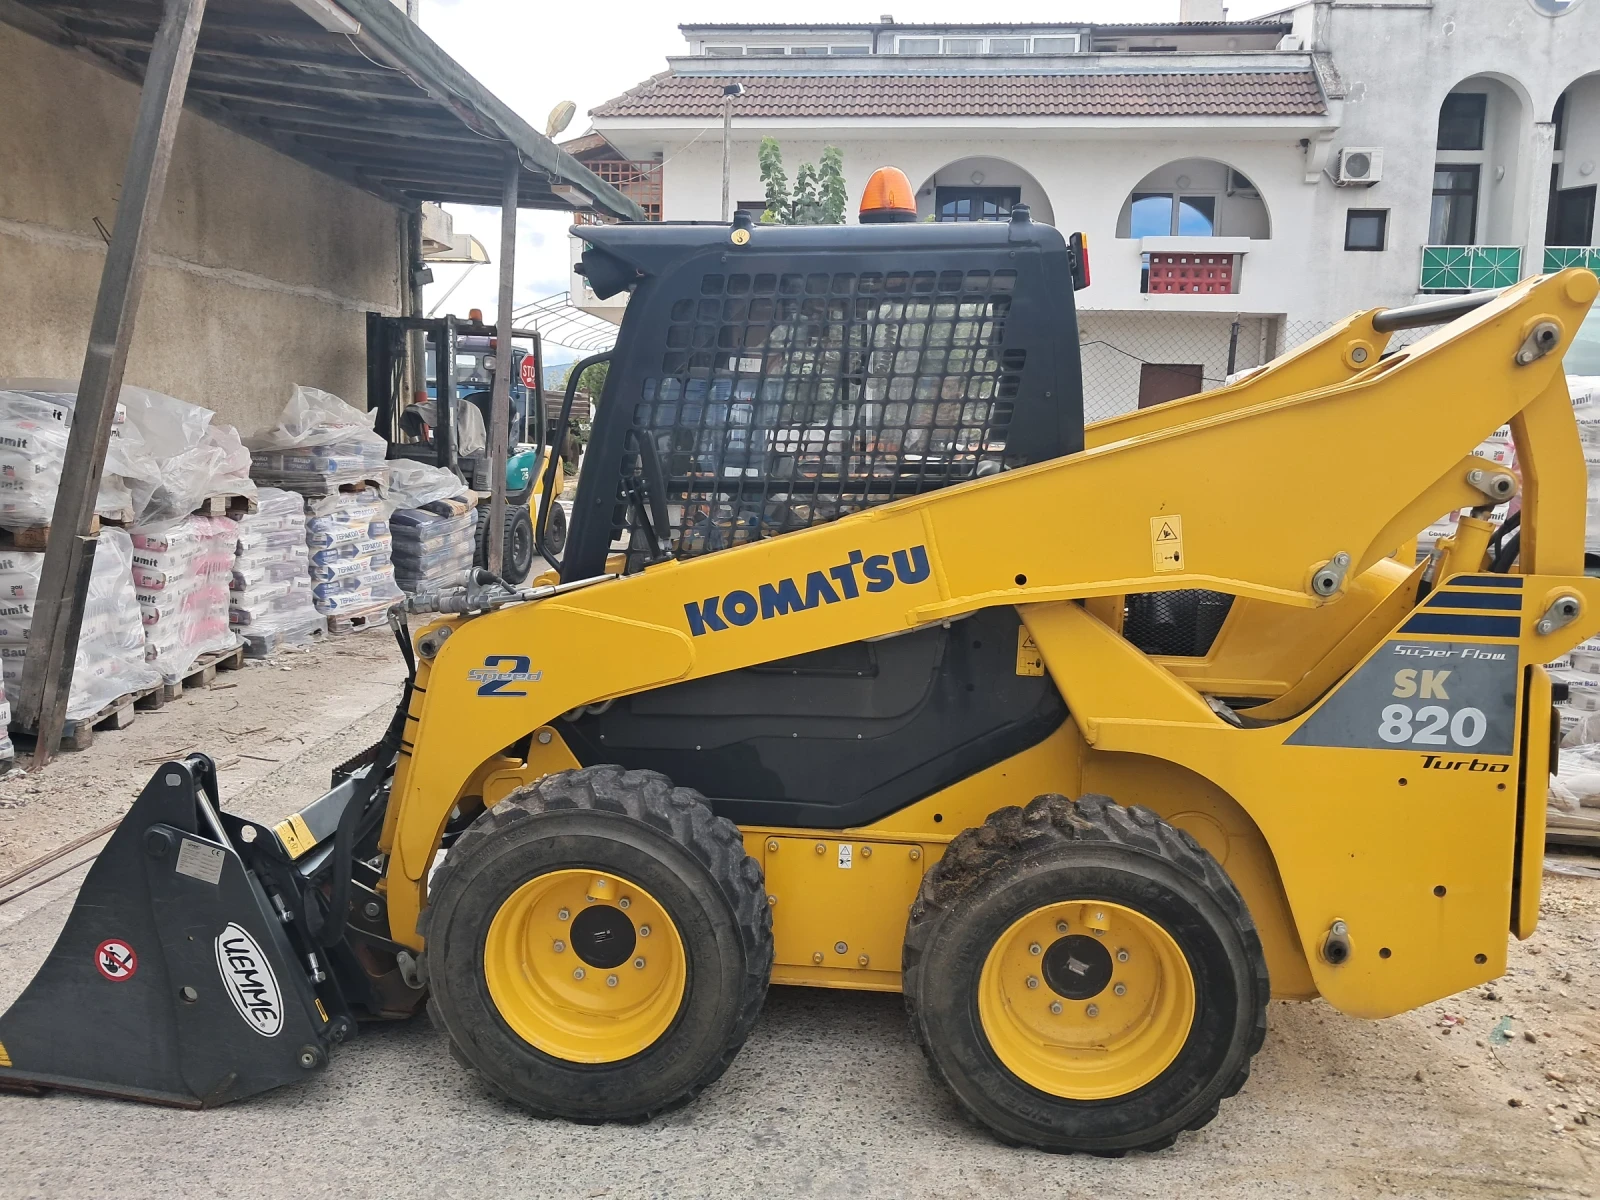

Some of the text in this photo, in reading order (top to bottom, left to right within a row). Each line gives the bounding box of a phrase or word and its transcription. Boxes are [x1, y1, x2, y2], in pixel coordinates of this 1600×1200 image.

[684, 545, 930, 637] KOMATSU
[1393, 644, 1460, 659] Super
[466, 668, 543, 685] Speed
[477, 655, 531, 697] 2
[1391, 668, 1453, 700] SK
[1377, 703, 1488, 747] 820
[1419, 754, 1511, 773] Turbo
